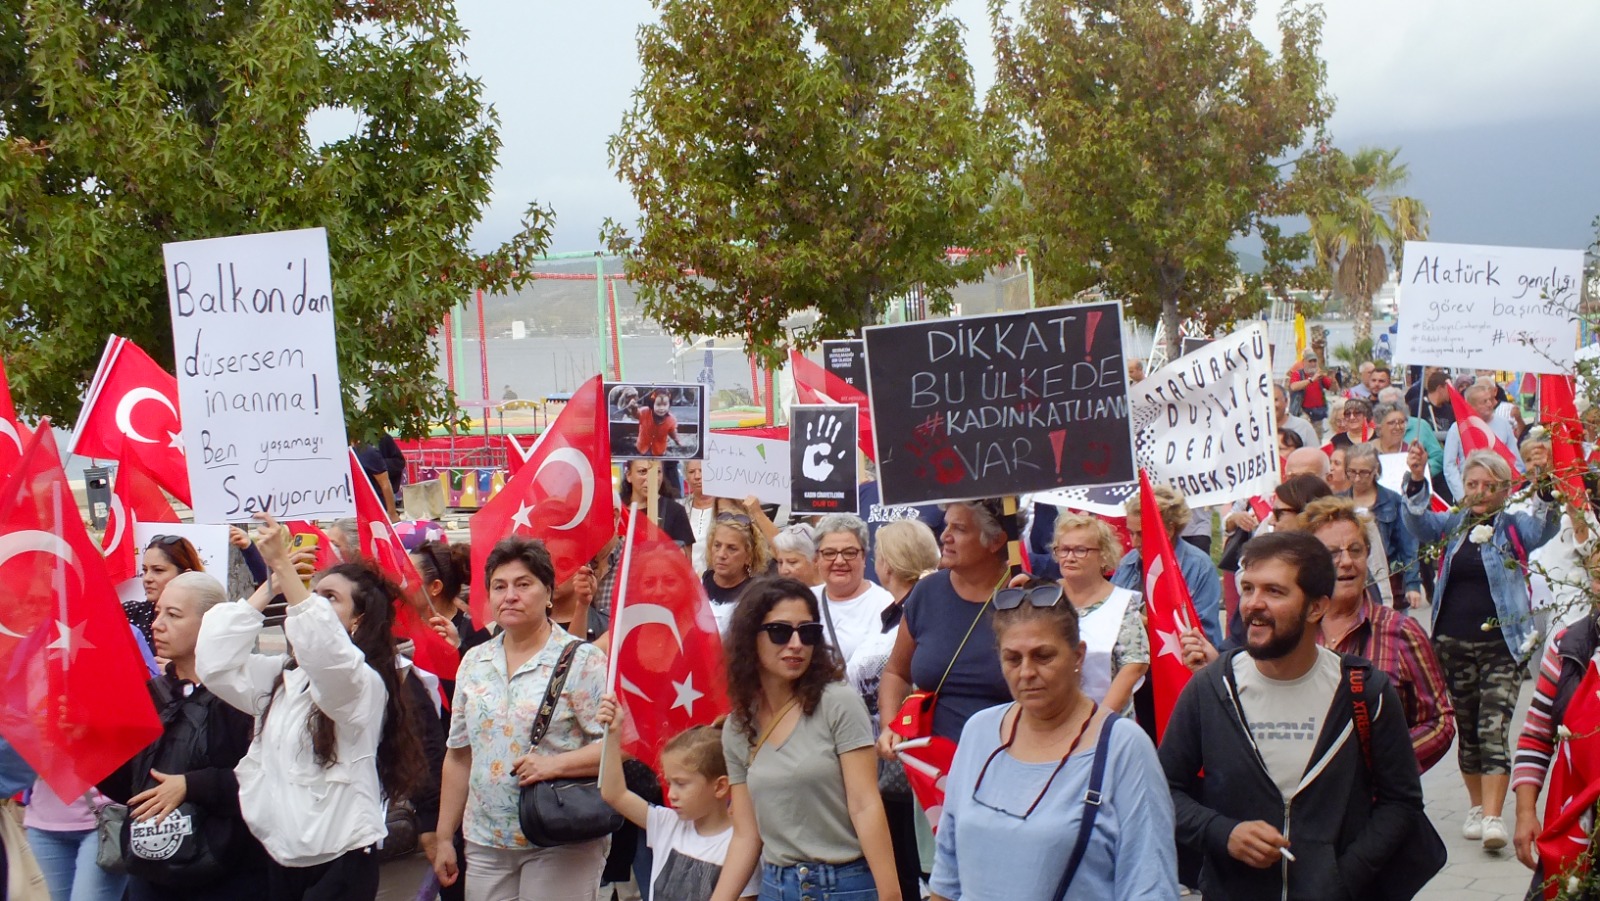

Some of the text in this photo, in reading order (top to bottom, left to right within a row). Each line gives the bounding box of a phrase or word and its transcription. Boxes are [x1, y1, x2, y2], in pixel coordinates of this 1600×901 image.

[1412, 256, 1500, 286] Atatürk
[173, 258, 331, 317] Balkon'dan
[1427, 300, 1475, 322] görev
[184, 328, 304, 380] düşersem
[204, 374, 320, 417] inanma!
[910, 354, 1121, 409] BU ÜLKEDE
[201, 430, 324, 474] Ben yaşamayı
[703, 462, 790, 489] SUSMUYORU
[1168, 469, 1224, 497] ERDEK
[222, 473, 353, 518] Seviyorum!
[1349, 669, 1364, 694] LUB
[1249, 716, 1316, 740] mavi
[132, 822, 181, 838] BERLIN
